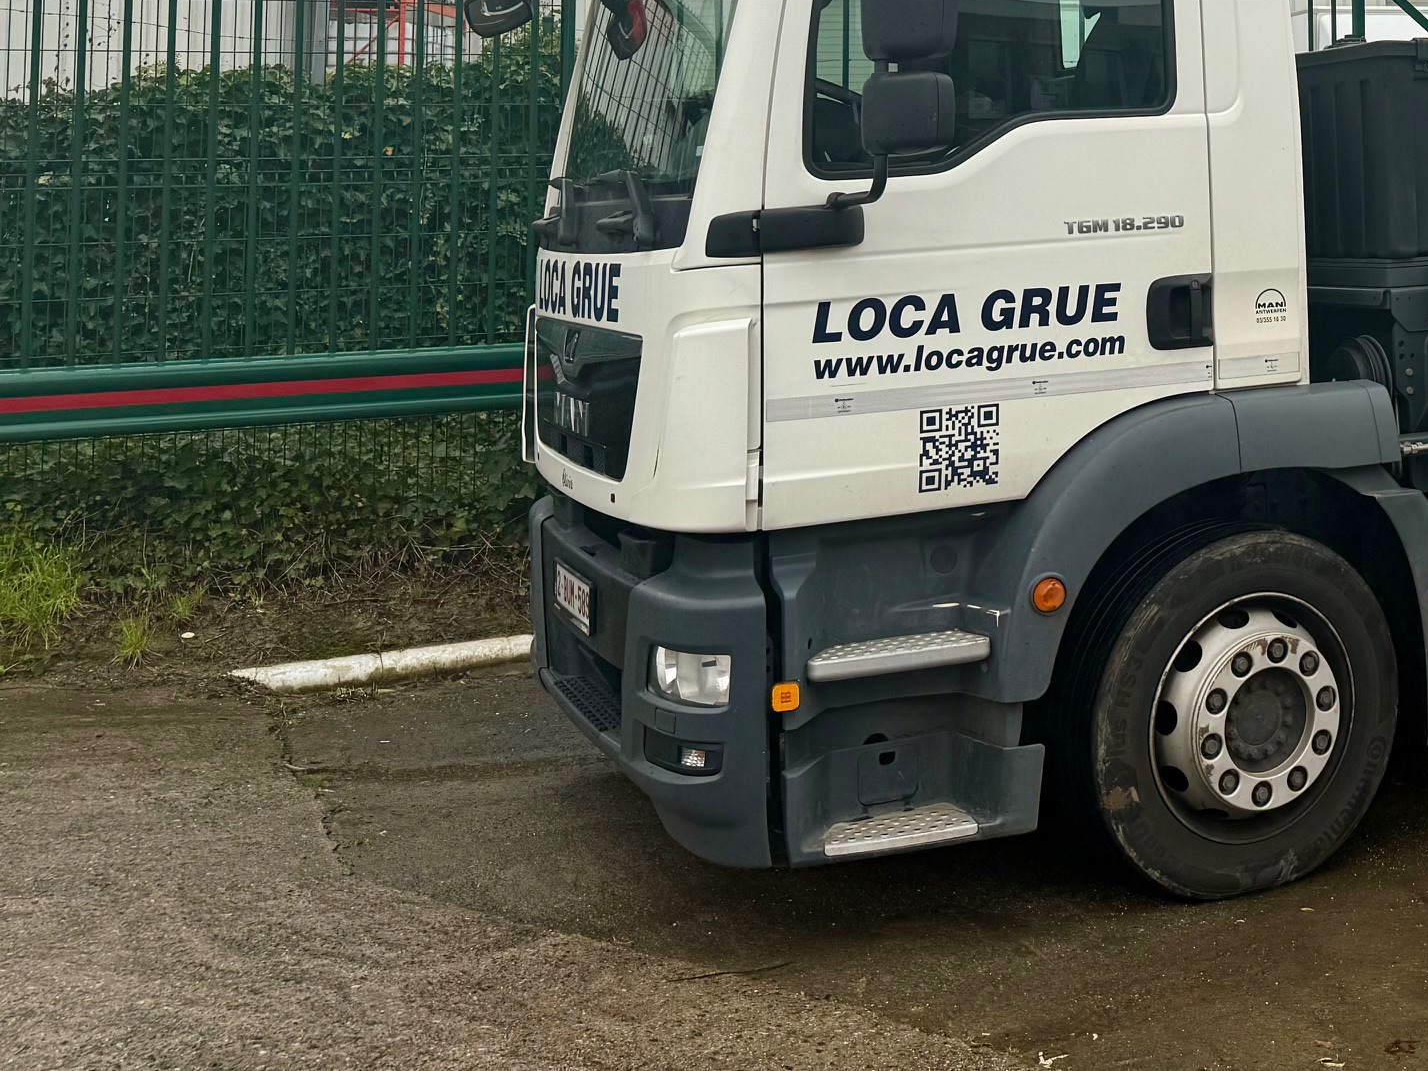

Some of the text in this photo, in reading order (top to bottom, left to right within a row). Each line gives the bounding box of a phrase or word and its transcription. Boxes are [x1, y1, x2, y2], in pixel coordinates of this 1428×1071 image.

[1063, 214, 1185, 235] TGM 18.290
[539, 258, 622, 323] LOCA GRUE
[812, 282, 1122, 344] LOCA GRUE
[1257, 301, 1284, 309] MAN
[814, 333, 1126, 380] www.locagrue.com
